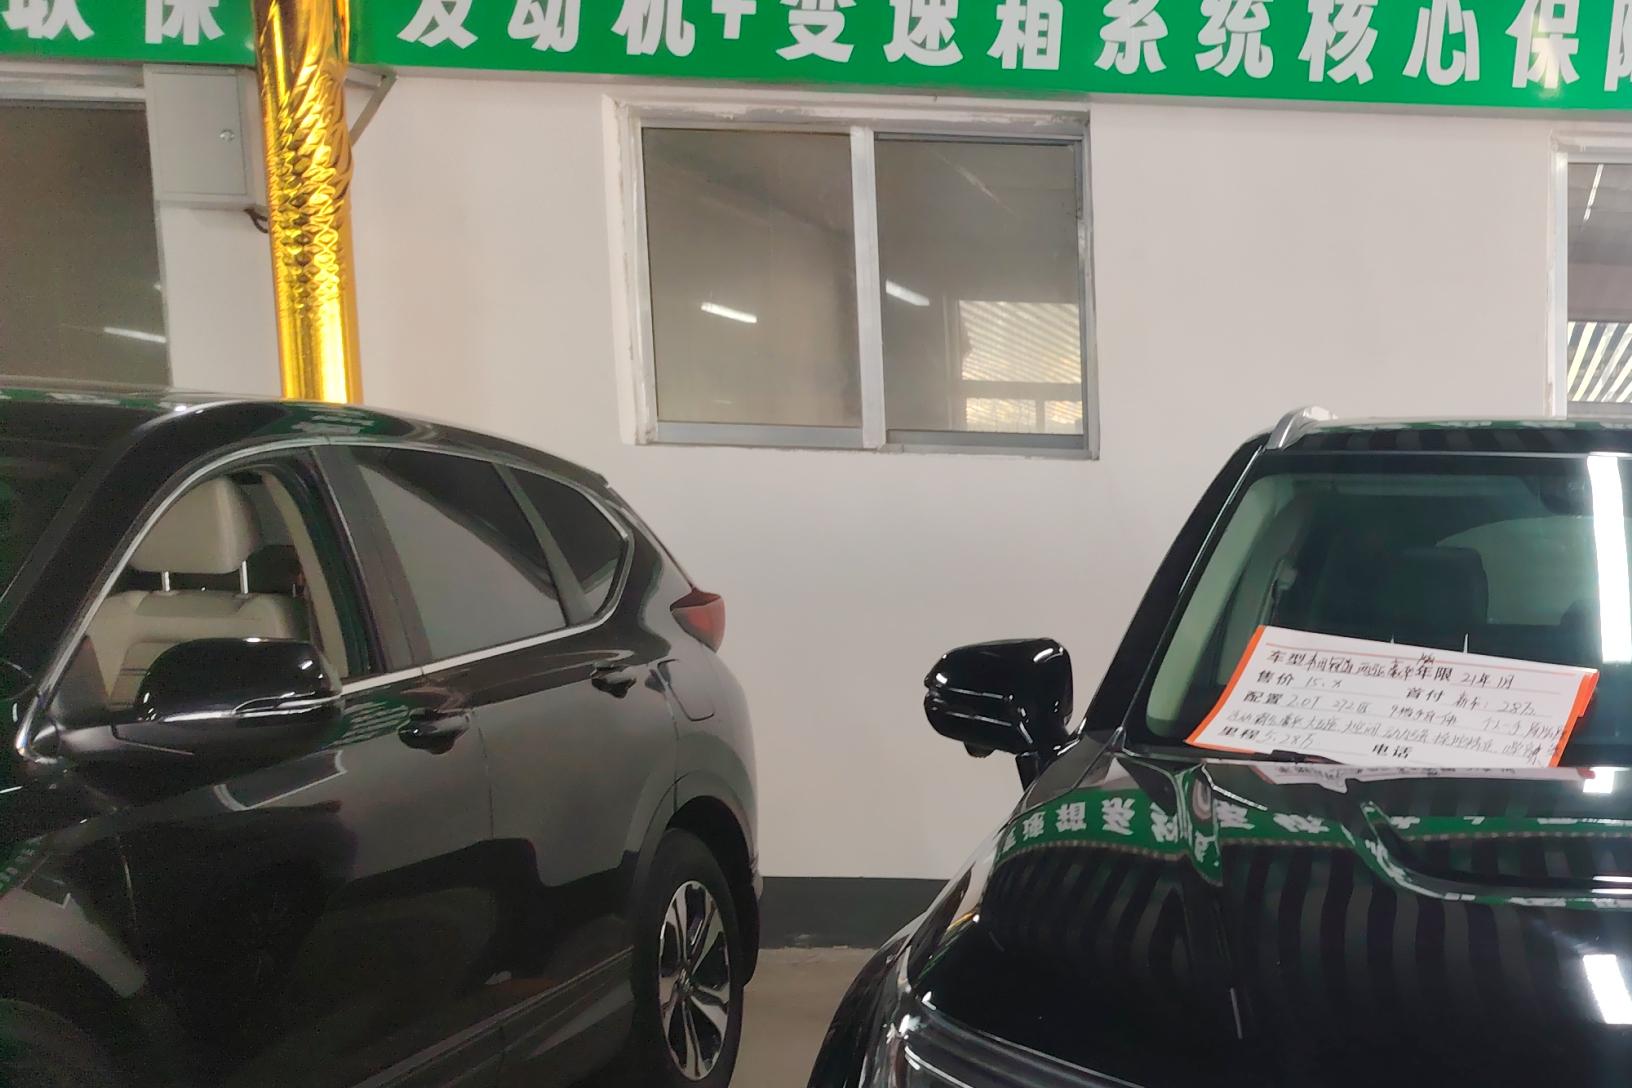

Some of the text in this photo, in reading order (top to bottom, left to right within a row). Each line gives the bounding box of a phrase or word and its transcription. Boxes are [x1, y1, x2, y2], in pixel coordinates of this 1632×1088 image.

[1267, 650, 1305, 667] 车型
[1257, 670, 1295, 687] 售价
[1243, 690, 1283, 705] 配置
[1371, 743, 1414, 759] 电话
